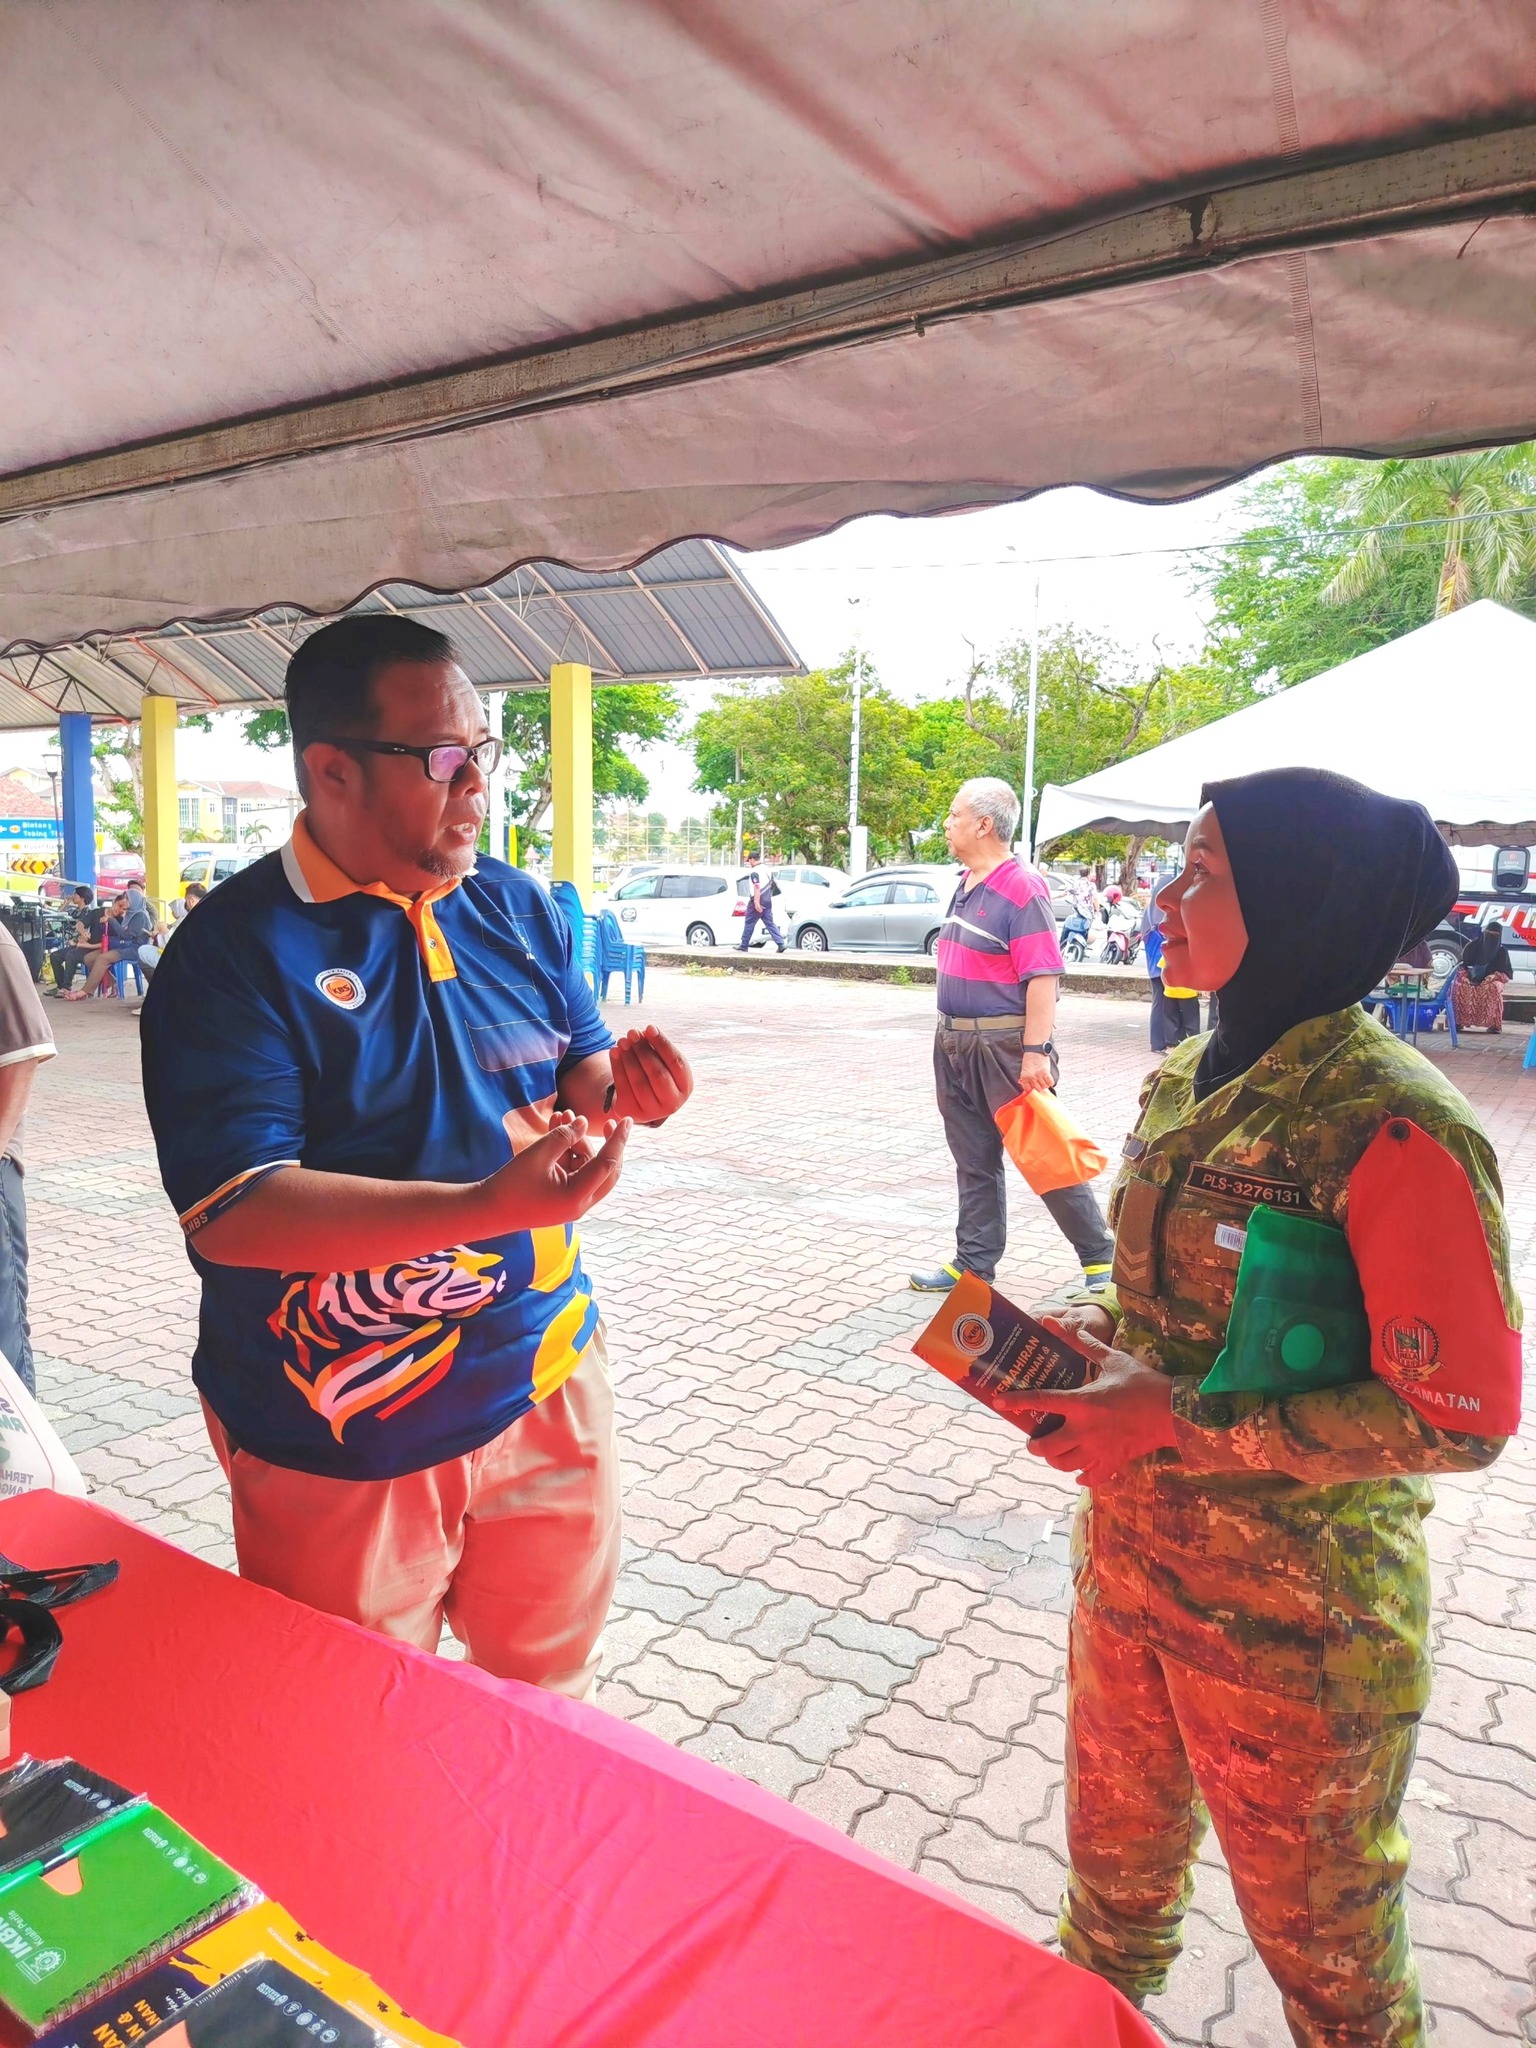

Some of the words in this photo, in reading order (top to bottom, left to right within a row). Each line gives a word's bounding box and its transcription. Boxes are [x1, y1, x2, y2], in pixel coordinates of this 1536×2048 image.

[1201, 1173, 1300, 1205] PLS-3276131
[1041, 1345, 1050, 1355] &
[991, 1335, 1040, 1398] KEMAHIRAN
[8, 1909, 28, 1930] Perlis
[25, 1926, 45, 1947] Kuala
